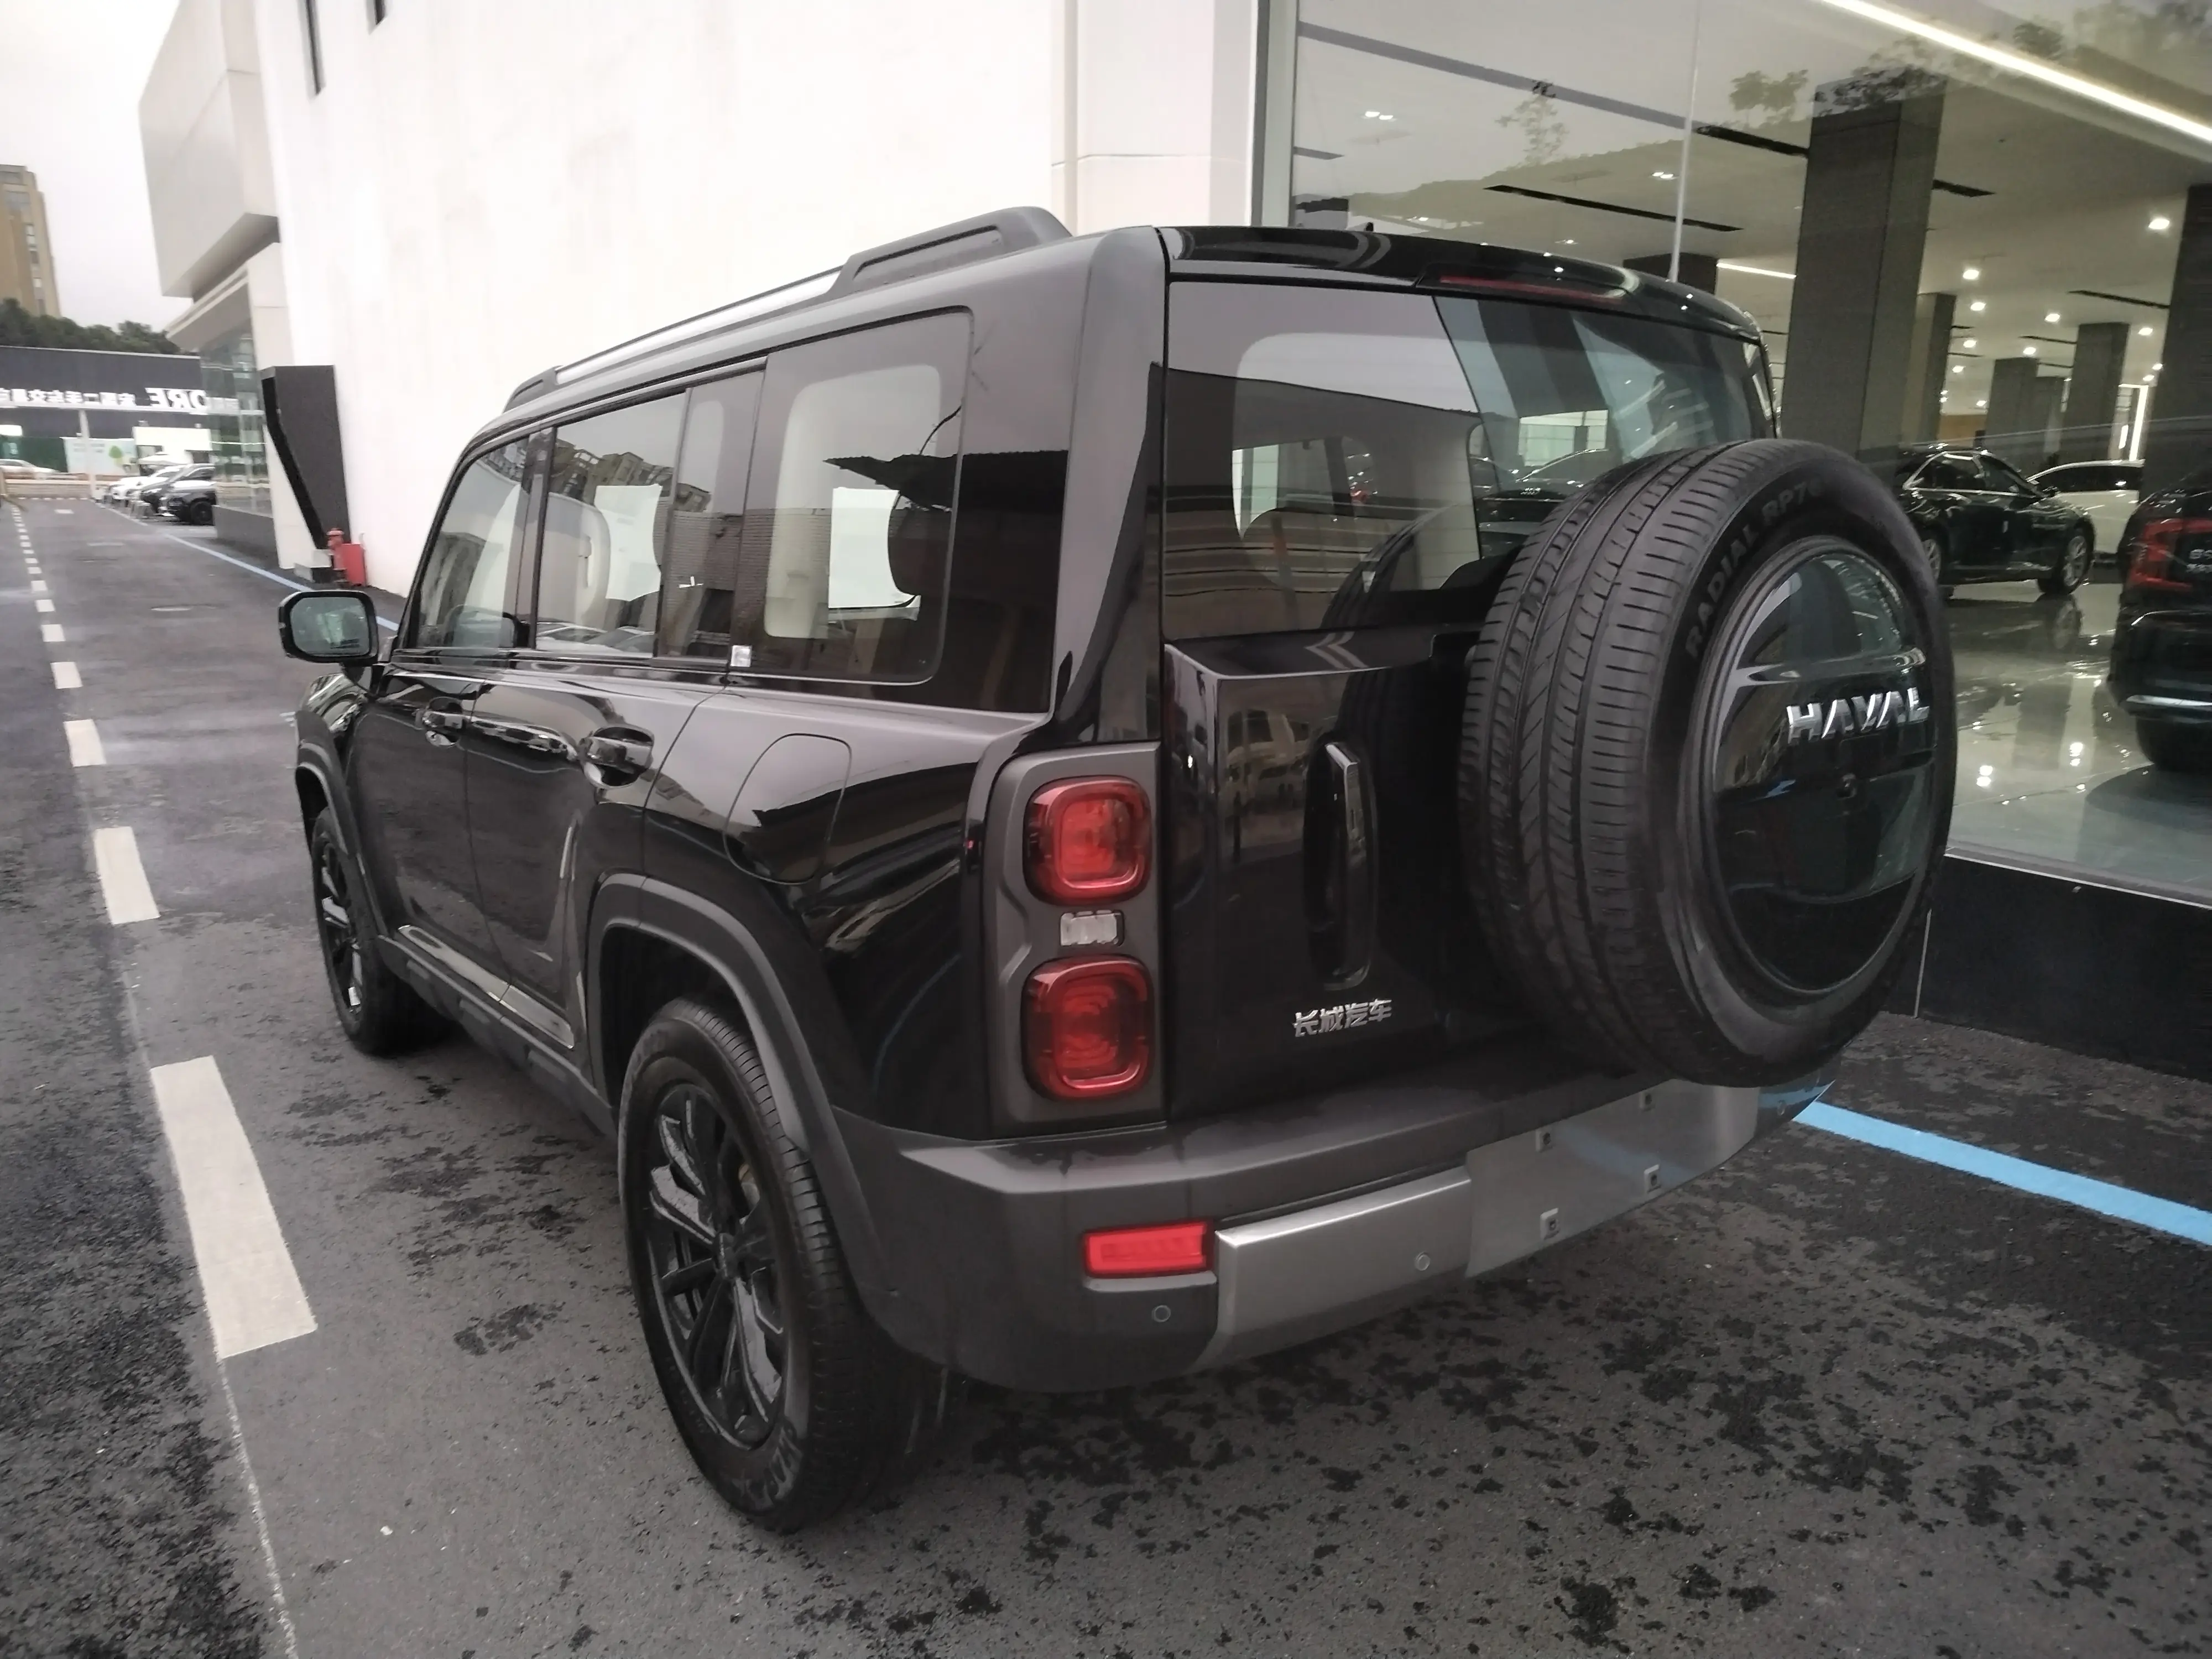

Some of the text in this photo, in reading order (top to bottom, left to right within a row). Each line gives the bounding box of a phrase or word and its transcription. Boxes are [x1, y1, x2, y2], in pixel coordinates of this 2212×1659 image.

[1685, 523, 1759, 659] RADIAL
[1786, 687, 1929, 744] HAVAL
[1292, 998, 1393, 1037] 长城汽车
